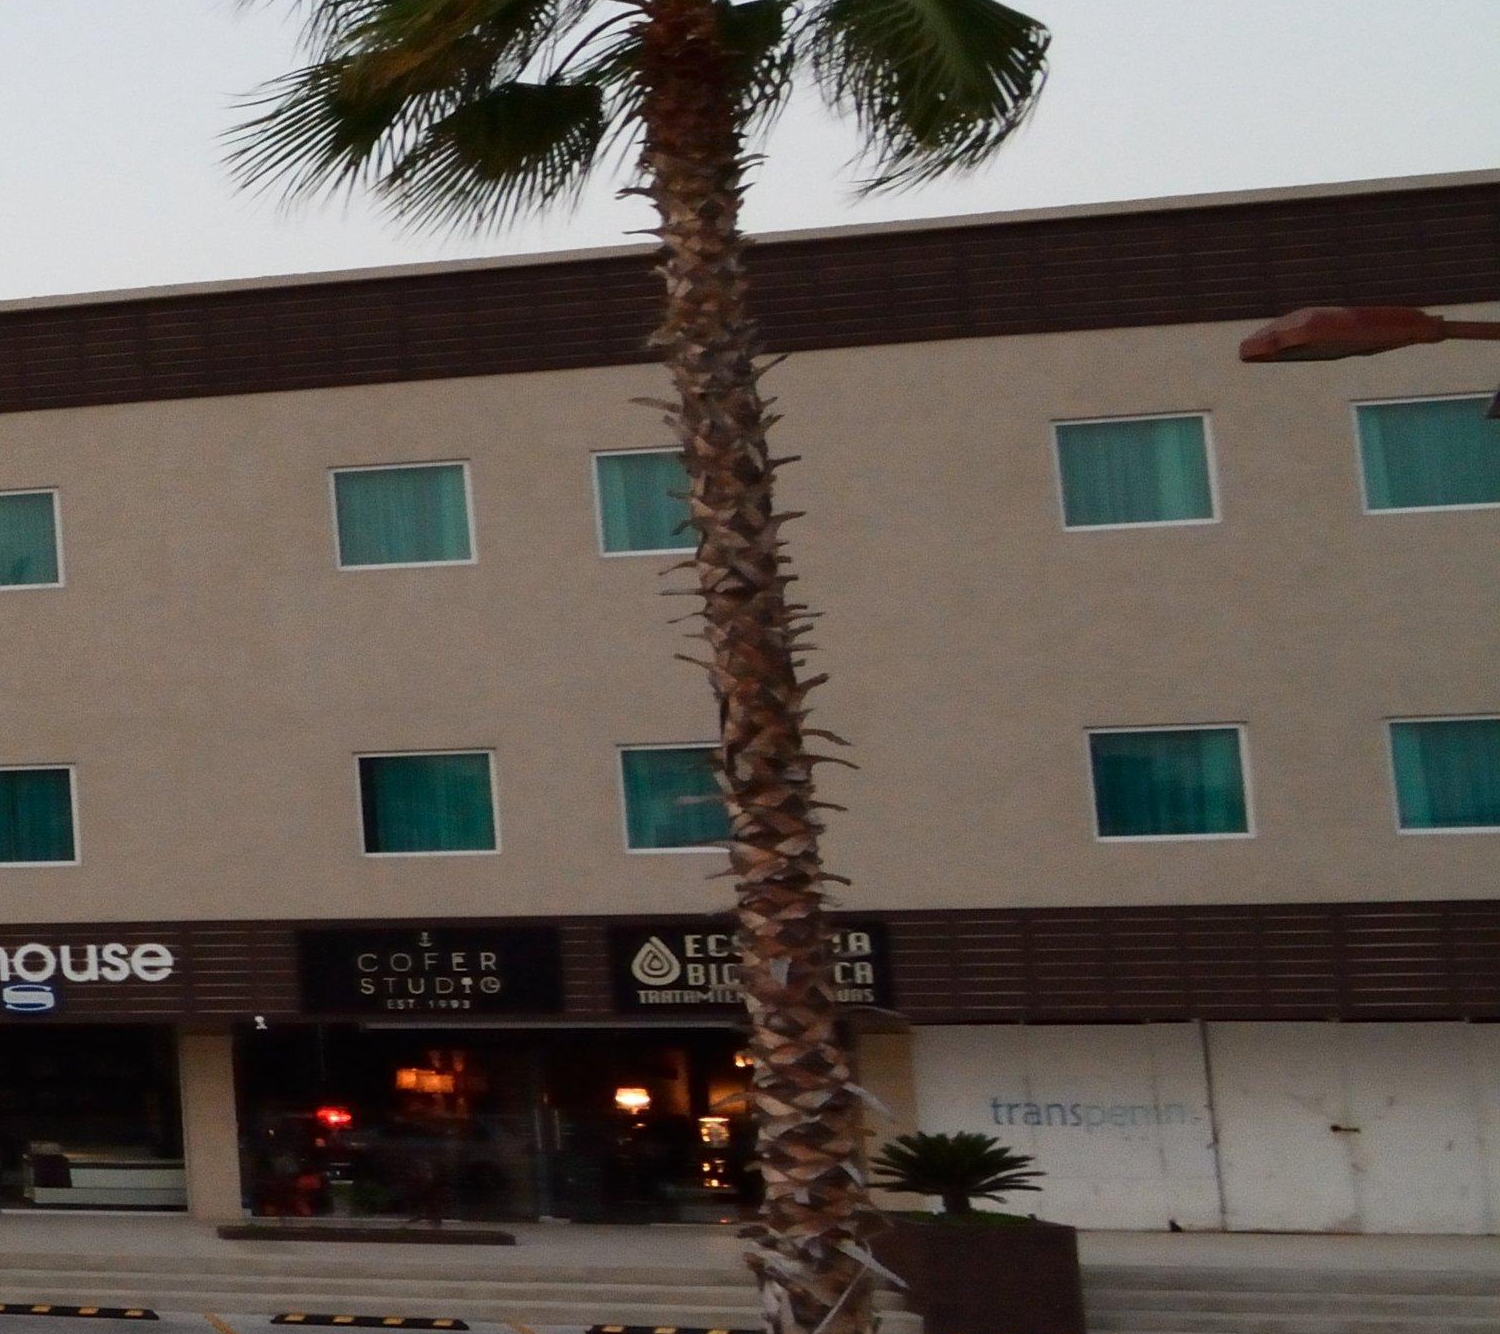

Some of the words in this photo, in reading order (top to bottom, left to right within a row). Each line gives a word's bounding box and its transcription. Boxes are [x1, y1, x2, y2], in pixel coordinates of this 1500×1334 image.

[357, 952, 497, 972] COFER
[360, 976, 500, 995] STUDIO
[387, 999, 421, 1009] EST.
[429, 999, 471, 1009] 1993
